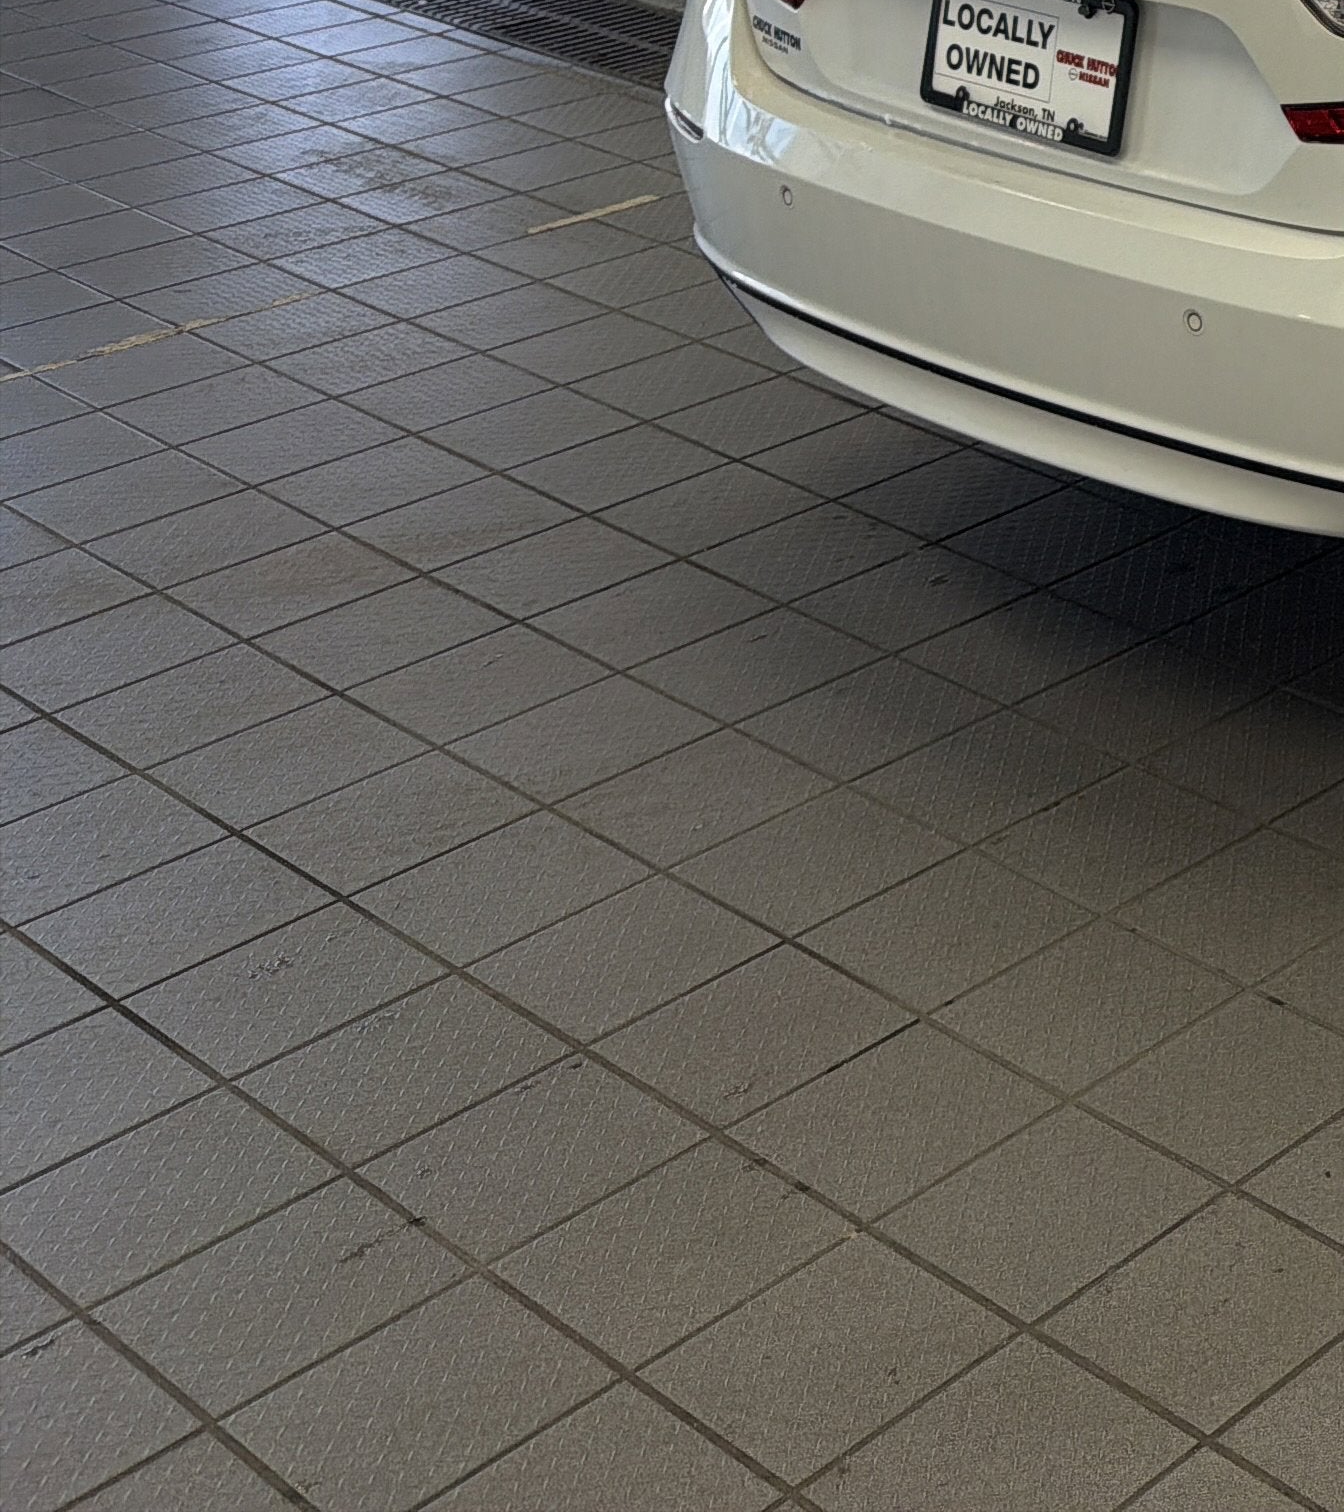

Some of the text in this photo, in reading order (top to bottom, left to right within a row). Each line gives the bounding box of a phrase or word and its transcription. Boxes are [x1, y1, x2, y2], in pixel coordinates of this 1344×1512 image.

[943, 0, 1056, 50] LOCALLY
[946, 44, 1041, 91] OWNED
[1056, 49, 1118, 77] CHUCK HUTTO
[962, 100, 1015, 127] LOCALLY
[1016, 117, 1064, 142] OWNED
[993, 96, 1056, 123] Jackson, TN
